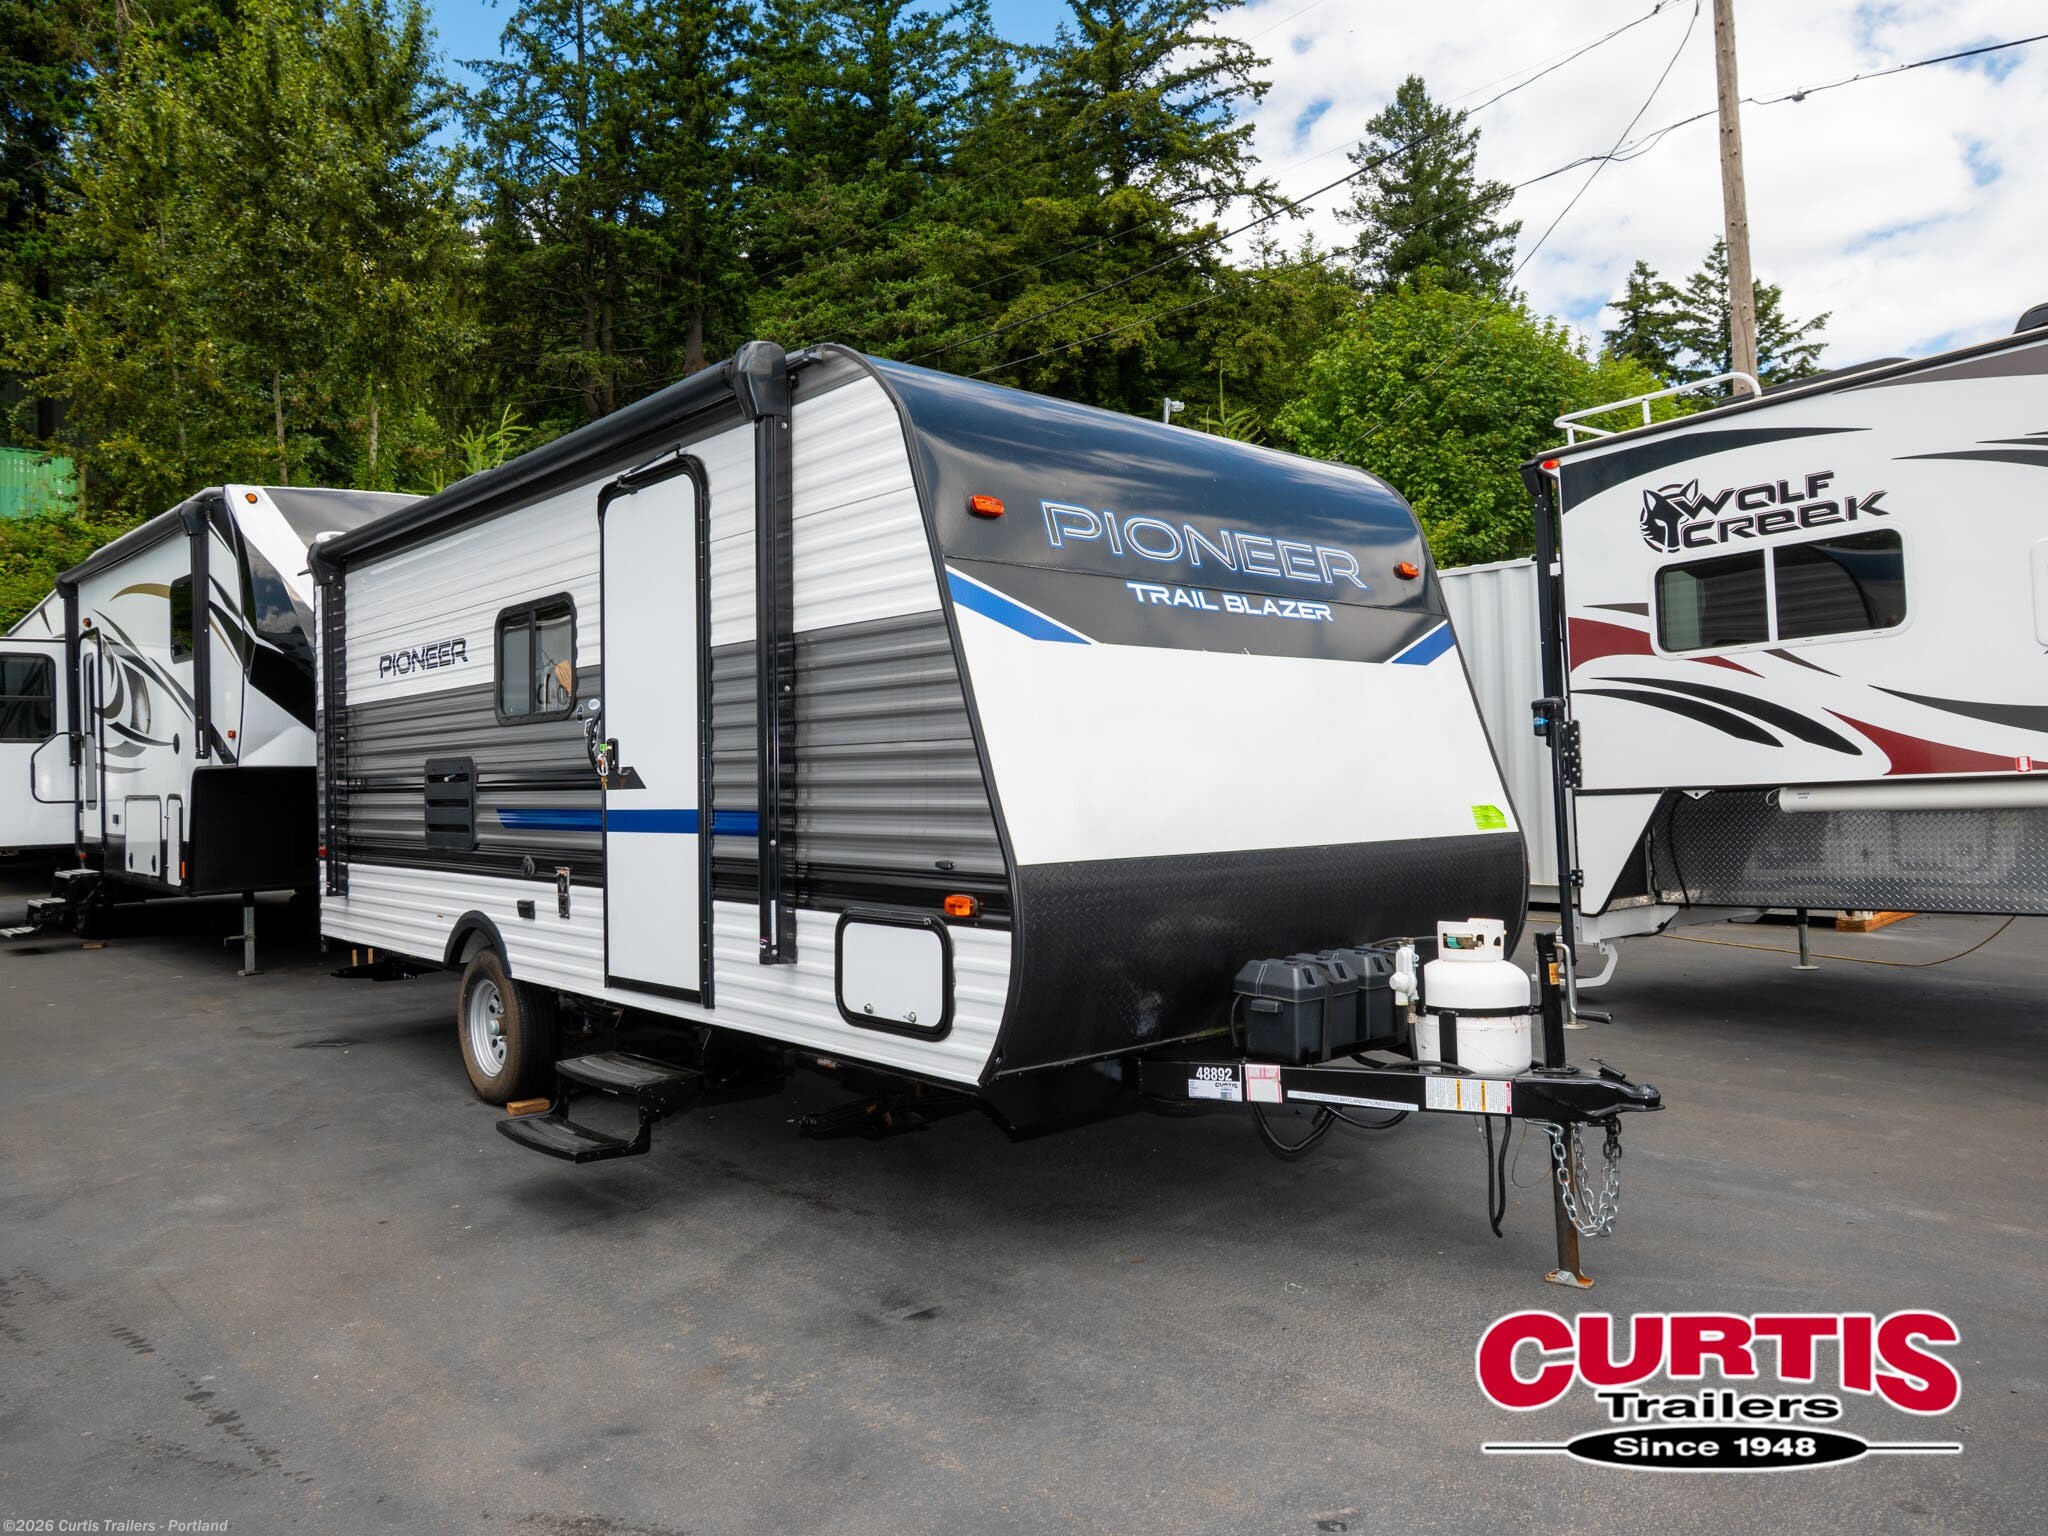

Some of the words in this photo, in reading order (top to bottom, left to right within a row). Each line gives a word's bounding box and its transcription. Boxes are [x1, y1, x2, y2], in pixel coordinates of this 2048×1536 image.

[1669, 469, 1835, 520] WOLF
[1040, 499, 1368, 589] PIONEER
[1125, 581, 1220, 611] TRAIL
[1222, 593, 1334, 622] BLAZER
[379, 637, 469, 679] PIONEER
[1195, 1066, 1233, 1081] 48892
